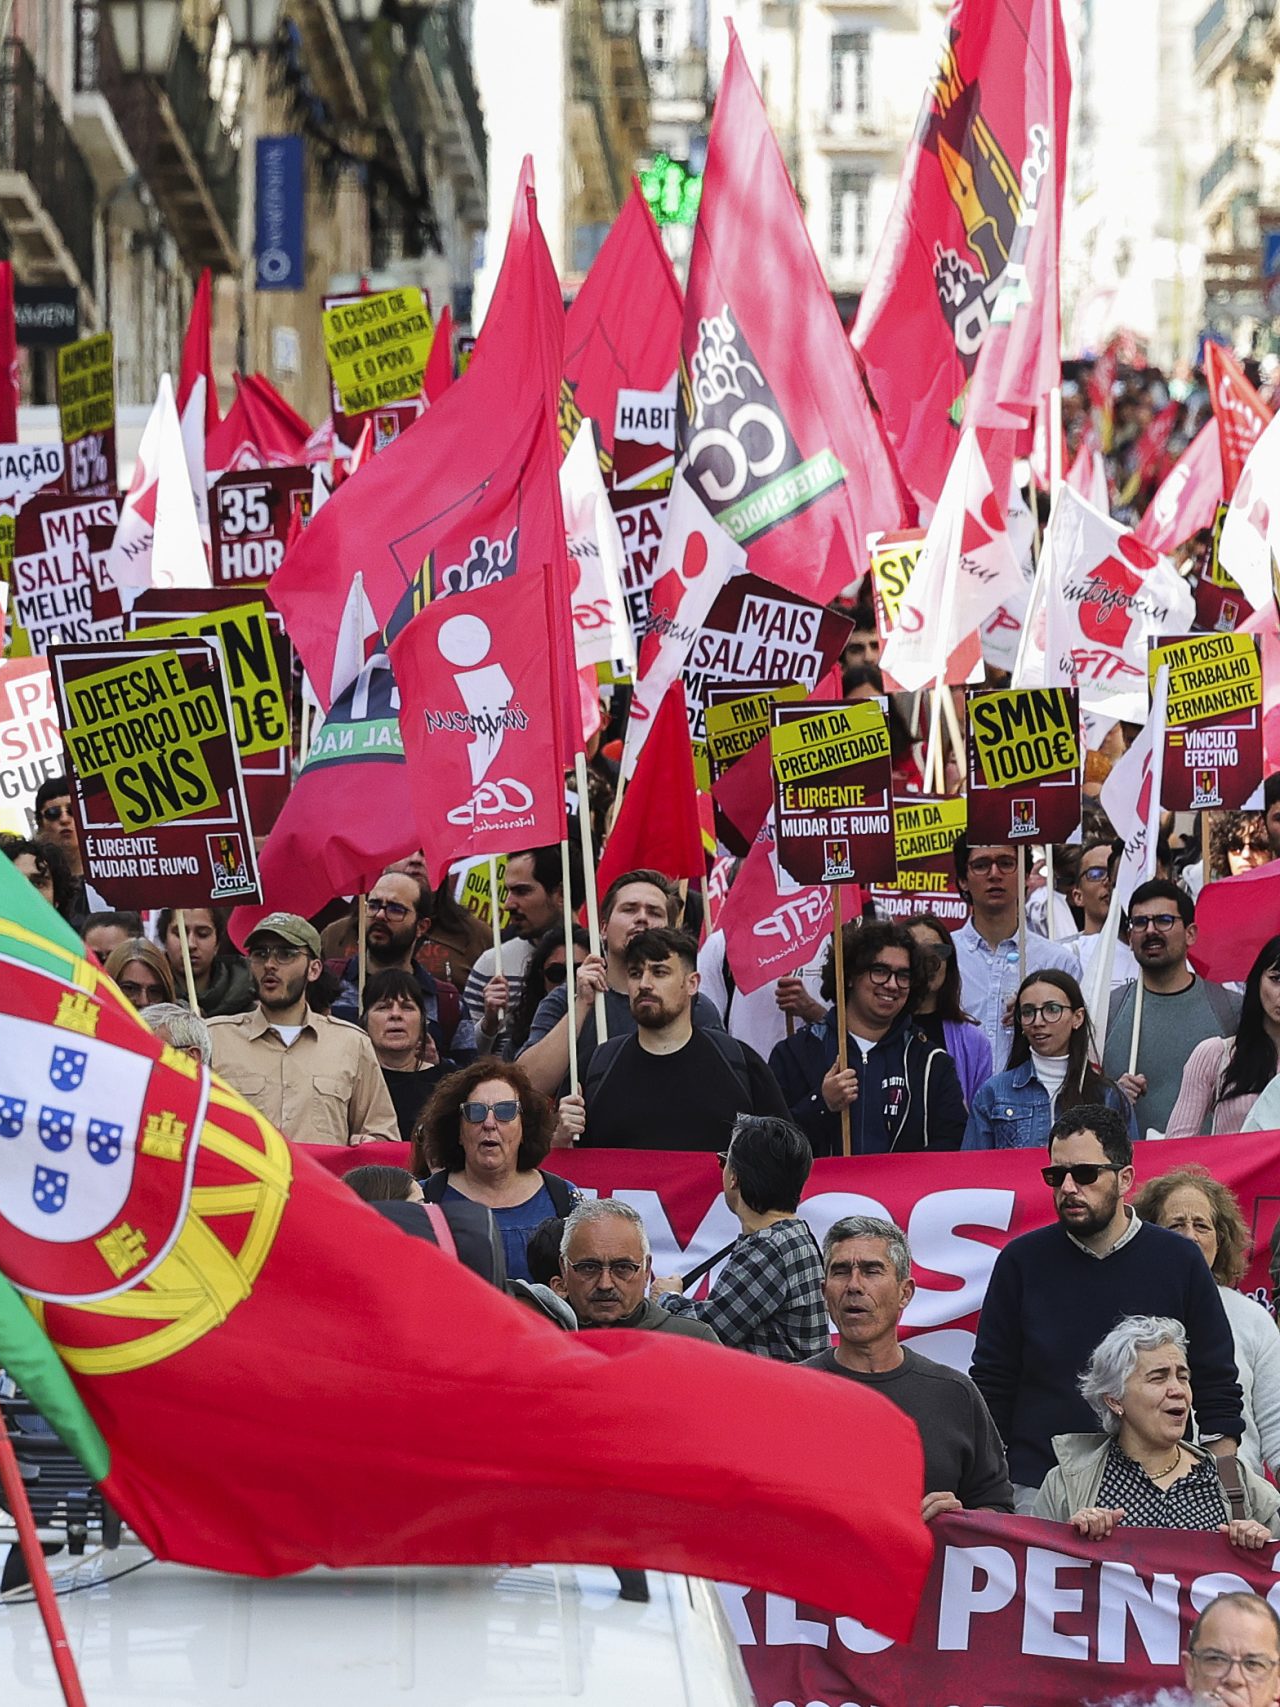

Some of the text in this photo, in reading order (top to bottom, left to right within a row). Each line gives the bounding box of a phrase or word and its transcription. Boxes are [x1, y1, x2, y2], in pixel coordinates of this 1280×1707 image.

[343, 299, 388, 330] CUSTO
[363, 314, 429, 347] AUMENTA
[376, 346, 416, 372] POVO
[71, 435, 108, 491] 15%
[222, 487, 270, 536] 35
[618, 503, 668, 545] PA
[741, 600, 816, 645] MAIS
[693, 634, 817, 680] SALÁRIO
[1163, 635, 1235, 670] UM POSTO
[74, 658, 186, 727] DEFESA E
[1179, 657, 1251, 693] TRABALHO
[730, 699, 759, 725] FIM
[974, 687, 1066, 747] SMN
[1166, 682, 1259, 723] PERMANENTE
[71, 694, 219, 773] REFORÇO DO
[798, 712, 852, 744] FIM DA
[1184, 729, 1237, 749] VÍNCULO
[778, 731, 890, 780] PRECARIEDADE
[984, 731, 1075, 783] 1000€
[1184, 749, 1239, 767] EFECTIVO
[113, 747, 208, 825] SNS
[785, 784, 866, 809] É URGENTE
[781, 814, 890, 838] MUDAR DE RUMO
[895, 806, 943, 832] FIM DA
[85, 834, 159, 857] É URGENTE
[89, 856, 200, 879] MUDAR DE RUMO
[217, 875, 249, 889] CGTP
